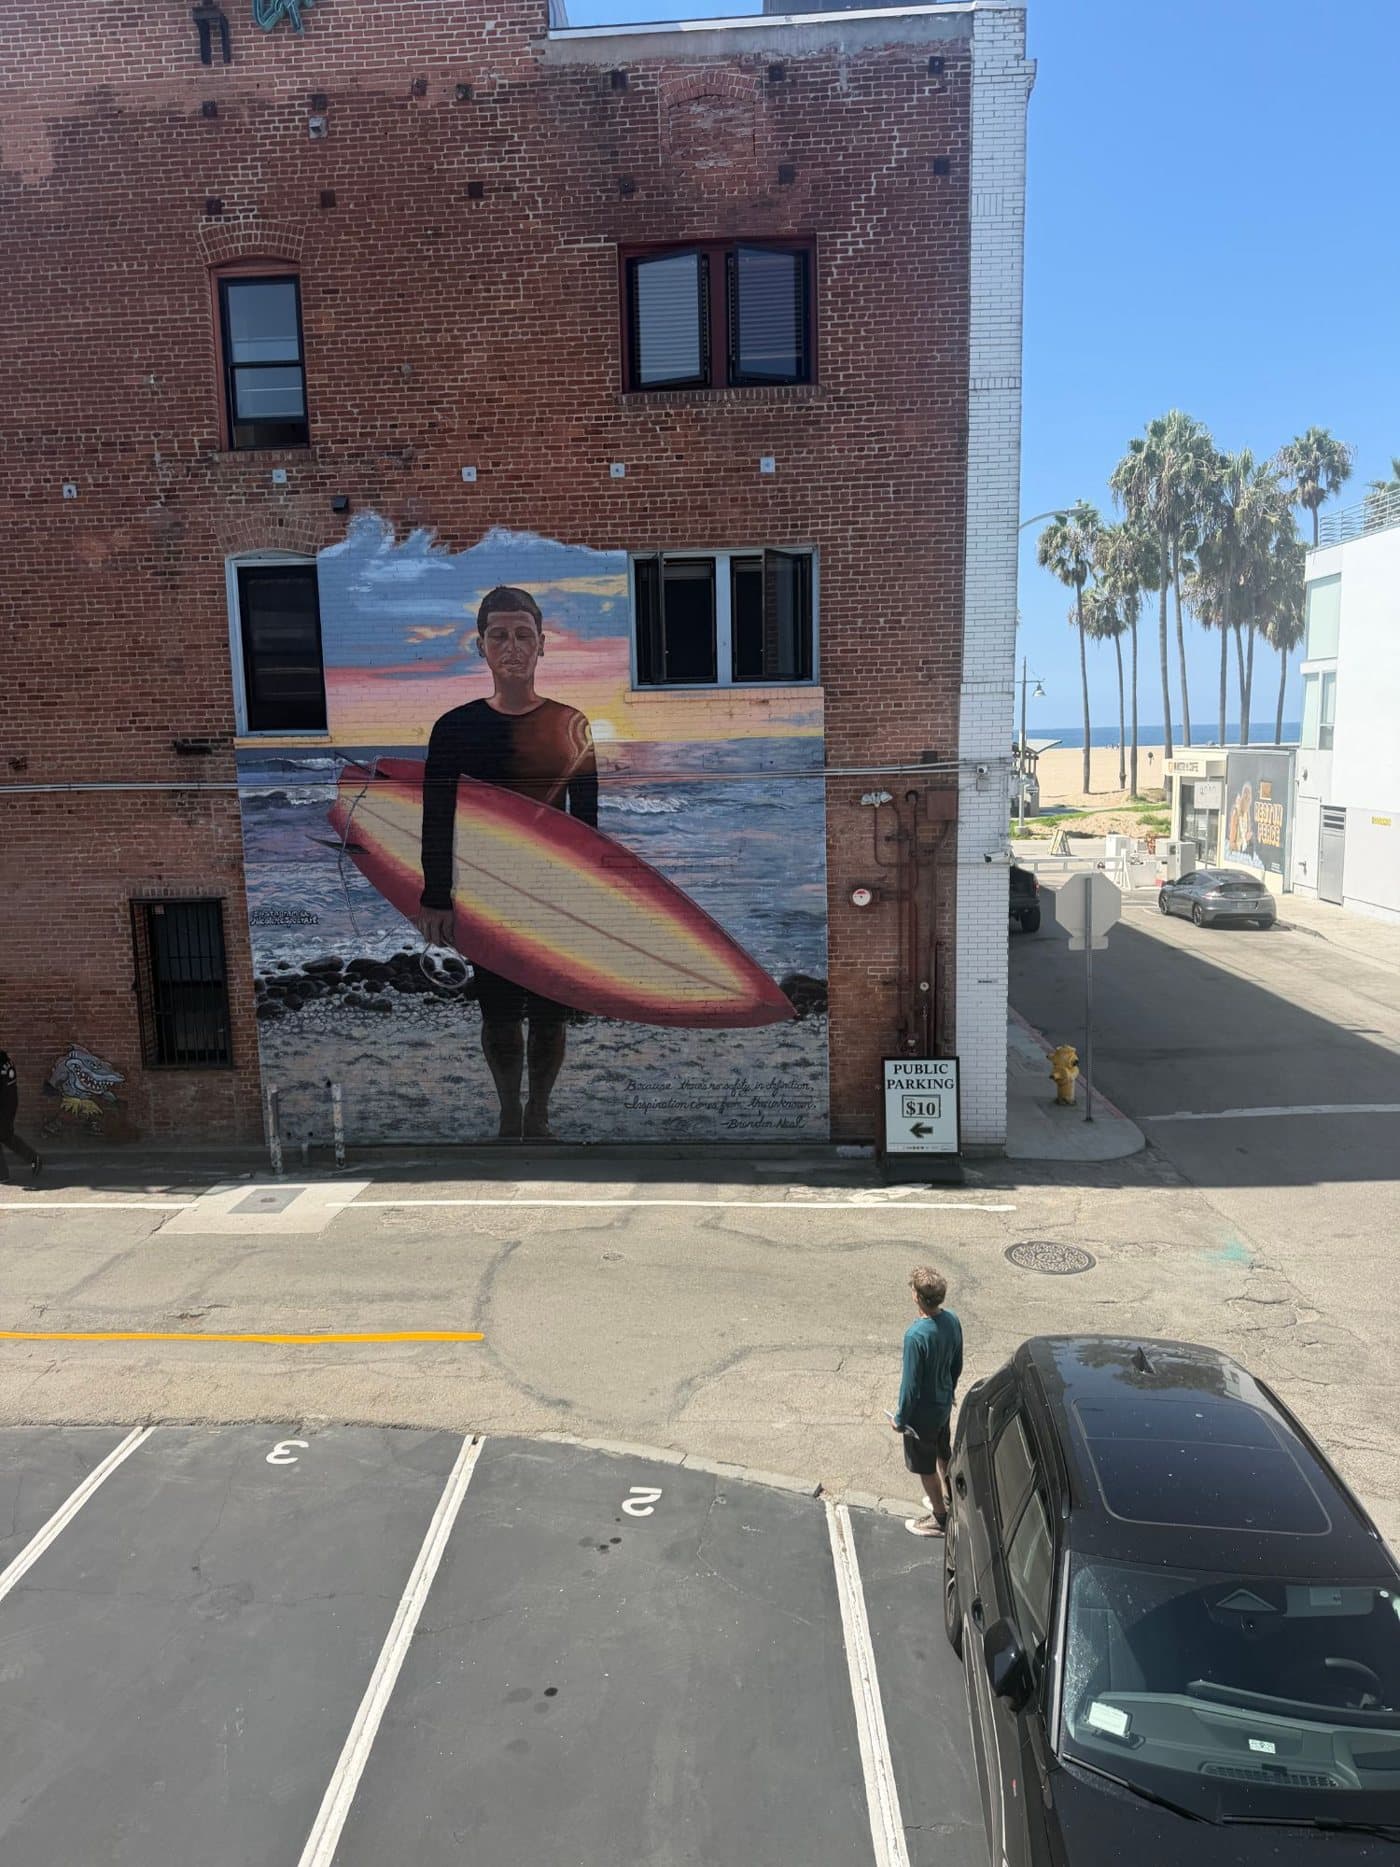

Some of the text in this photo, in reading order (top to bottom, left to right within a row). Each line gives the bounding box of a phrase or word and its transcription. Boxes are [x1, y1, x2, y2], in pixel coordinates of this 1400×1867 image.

[1258, 822, 1281, 848] PEACE
[893, 1063, 949, 1075] PUBLIC
[624, 1078, 672, 1091] Because
[886, 1078, 955, 1090] PARKING
[624, 1095, 689, 1115] Inspiration
[905, 1100, 936, 1117] $10
[265, 1439, 310, 1465] 3
[620, 1486, 663, 1518] 2
